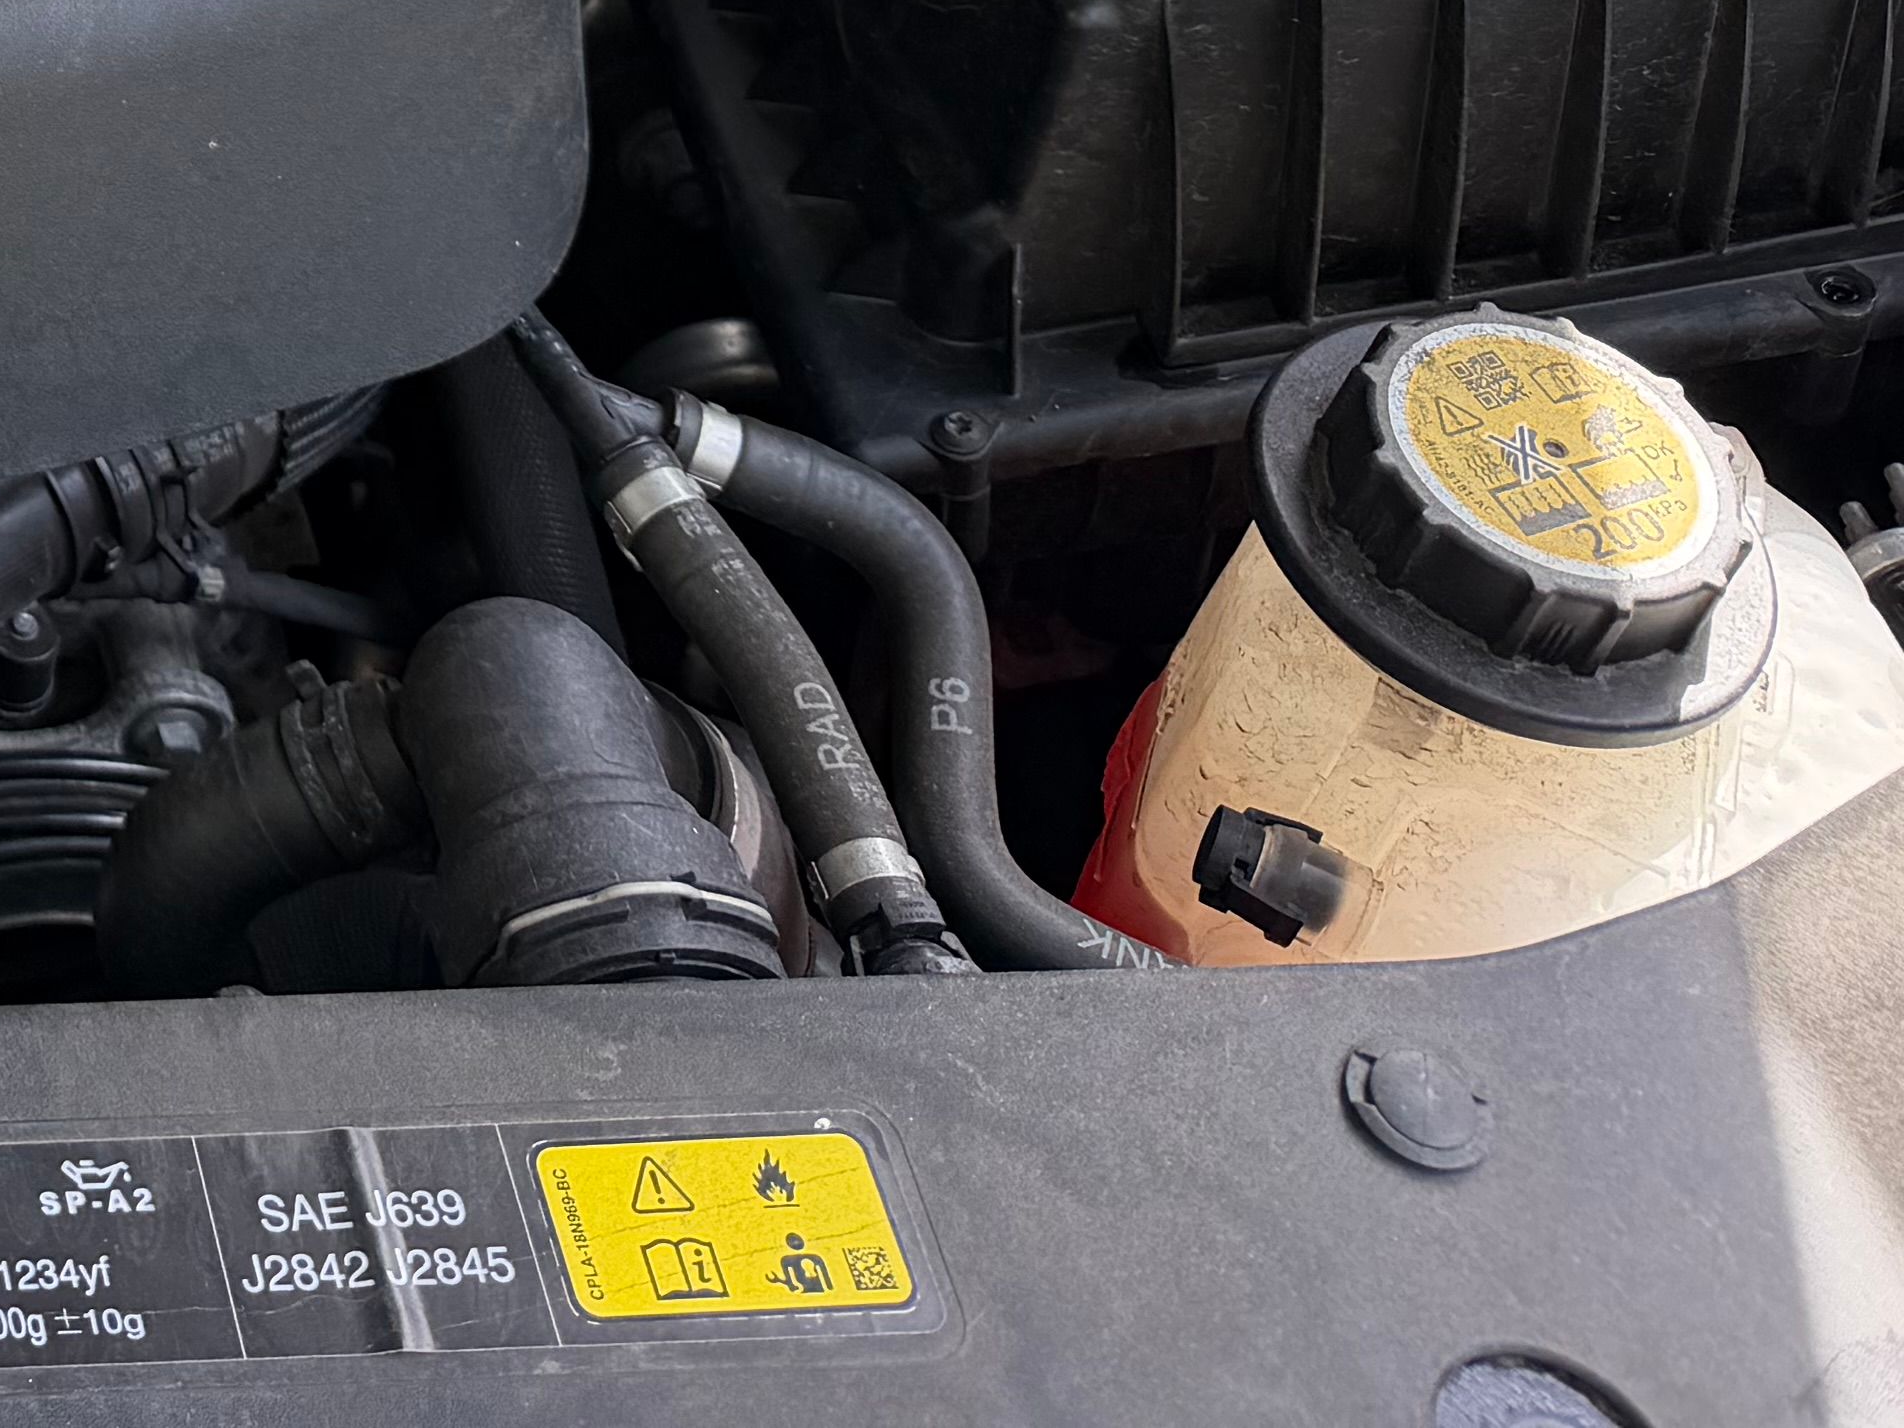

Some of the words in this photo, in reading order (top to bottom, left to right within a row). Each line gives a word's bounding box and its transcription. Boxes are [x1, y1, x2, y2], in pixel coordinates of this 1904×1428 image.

[1574, 509, 1666, 560] 200
[794, 681, 862, 771] RAD
[928, 677, 973, 735] P6
[39, 1187, 155, 1215] SP-A2
[258, 1191, 352, 1233] SAE
[366, 1190, 466, 1228] J639
[553, 1167, 605, 1300] CPLA-18N969-BC
[241, 1252, 374, 1292] J2842
[386, 1245, 516, 1287] J2845
[55, 1301, 146, 1342] ±10g
